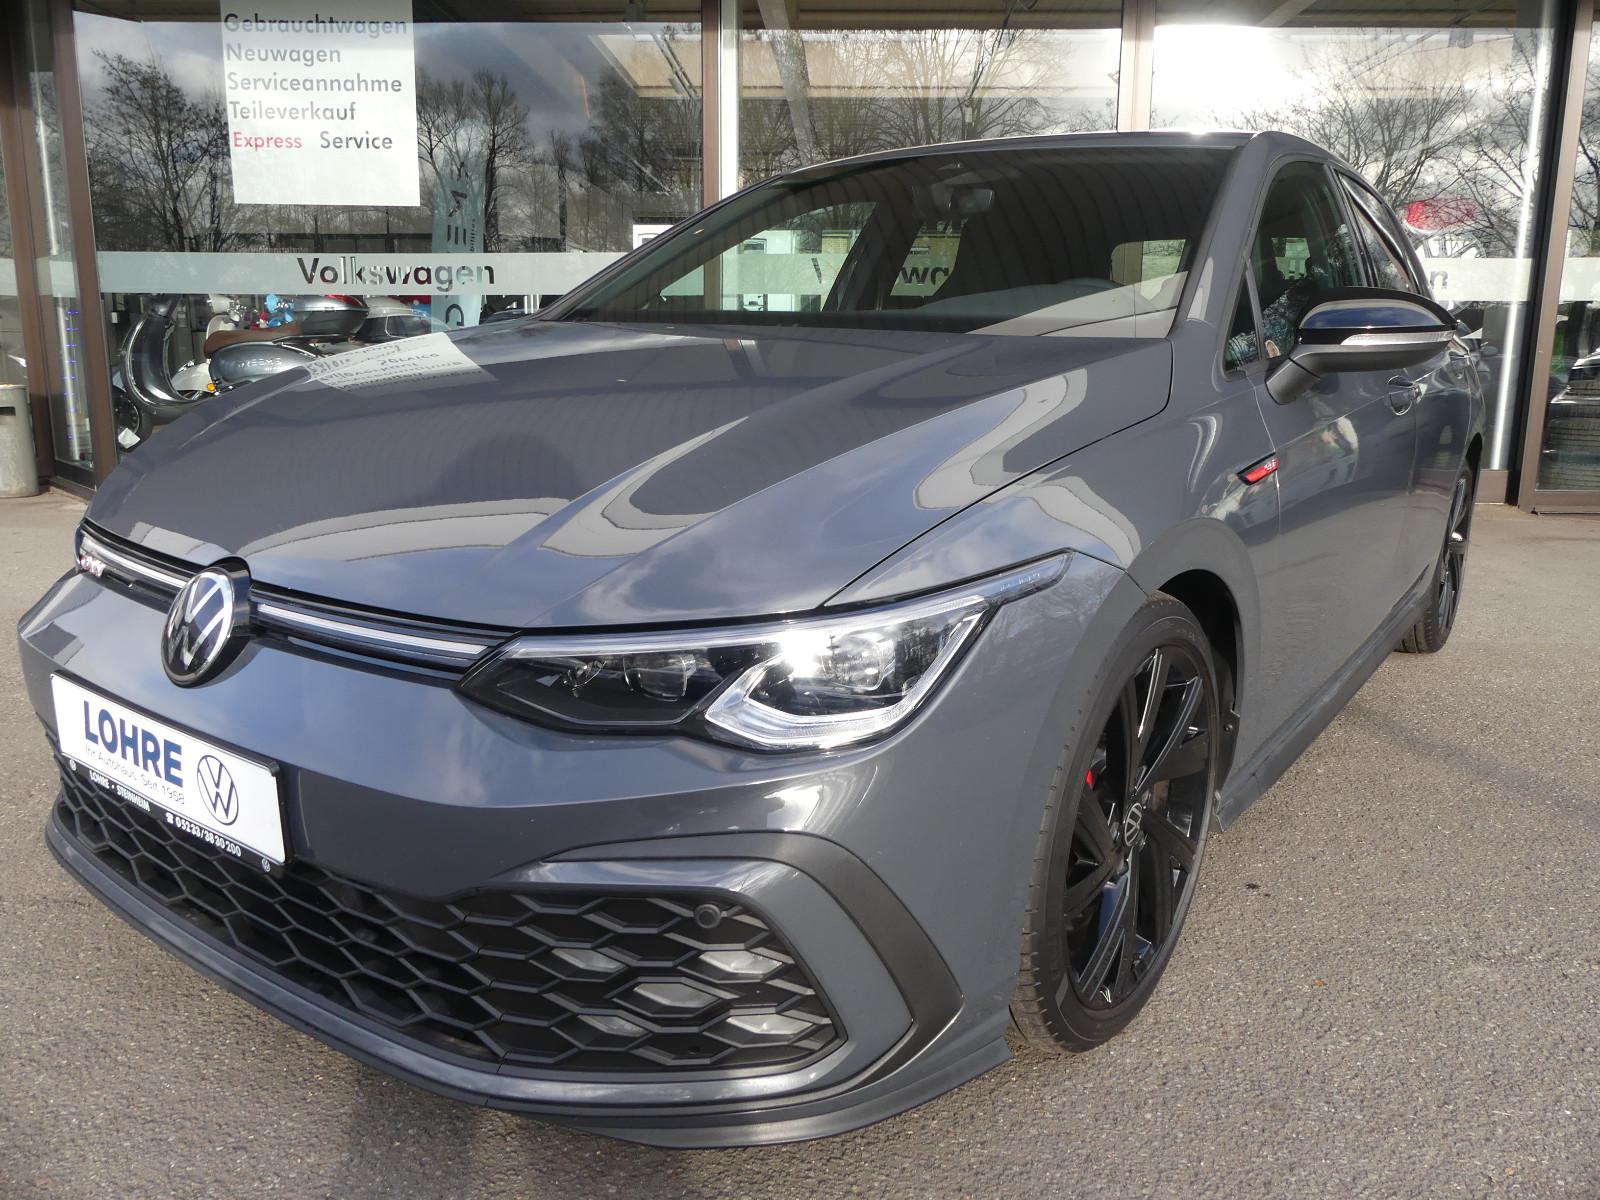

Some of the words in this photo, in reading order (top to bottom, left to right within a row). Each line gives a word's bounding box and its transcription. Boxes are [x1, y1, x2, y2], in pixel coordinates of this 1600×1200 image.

[224, 13, 407, 39] Gebrauchtwagen
[226, 43, 341, 67] Neuwagen
[227, 72, 403, 93] Serviceannahme
[229, 100, 357, 121] Teileverkauf
[233, 131, 302, 152] Express
[319, 130, 394, 150] Service
[296, 256, 495, 293] Volkswagen
[84, 699, 184, 788] LOHRE
[89, 770, 110, 789] LOHRE
[197, 754, 239, 826] VW
